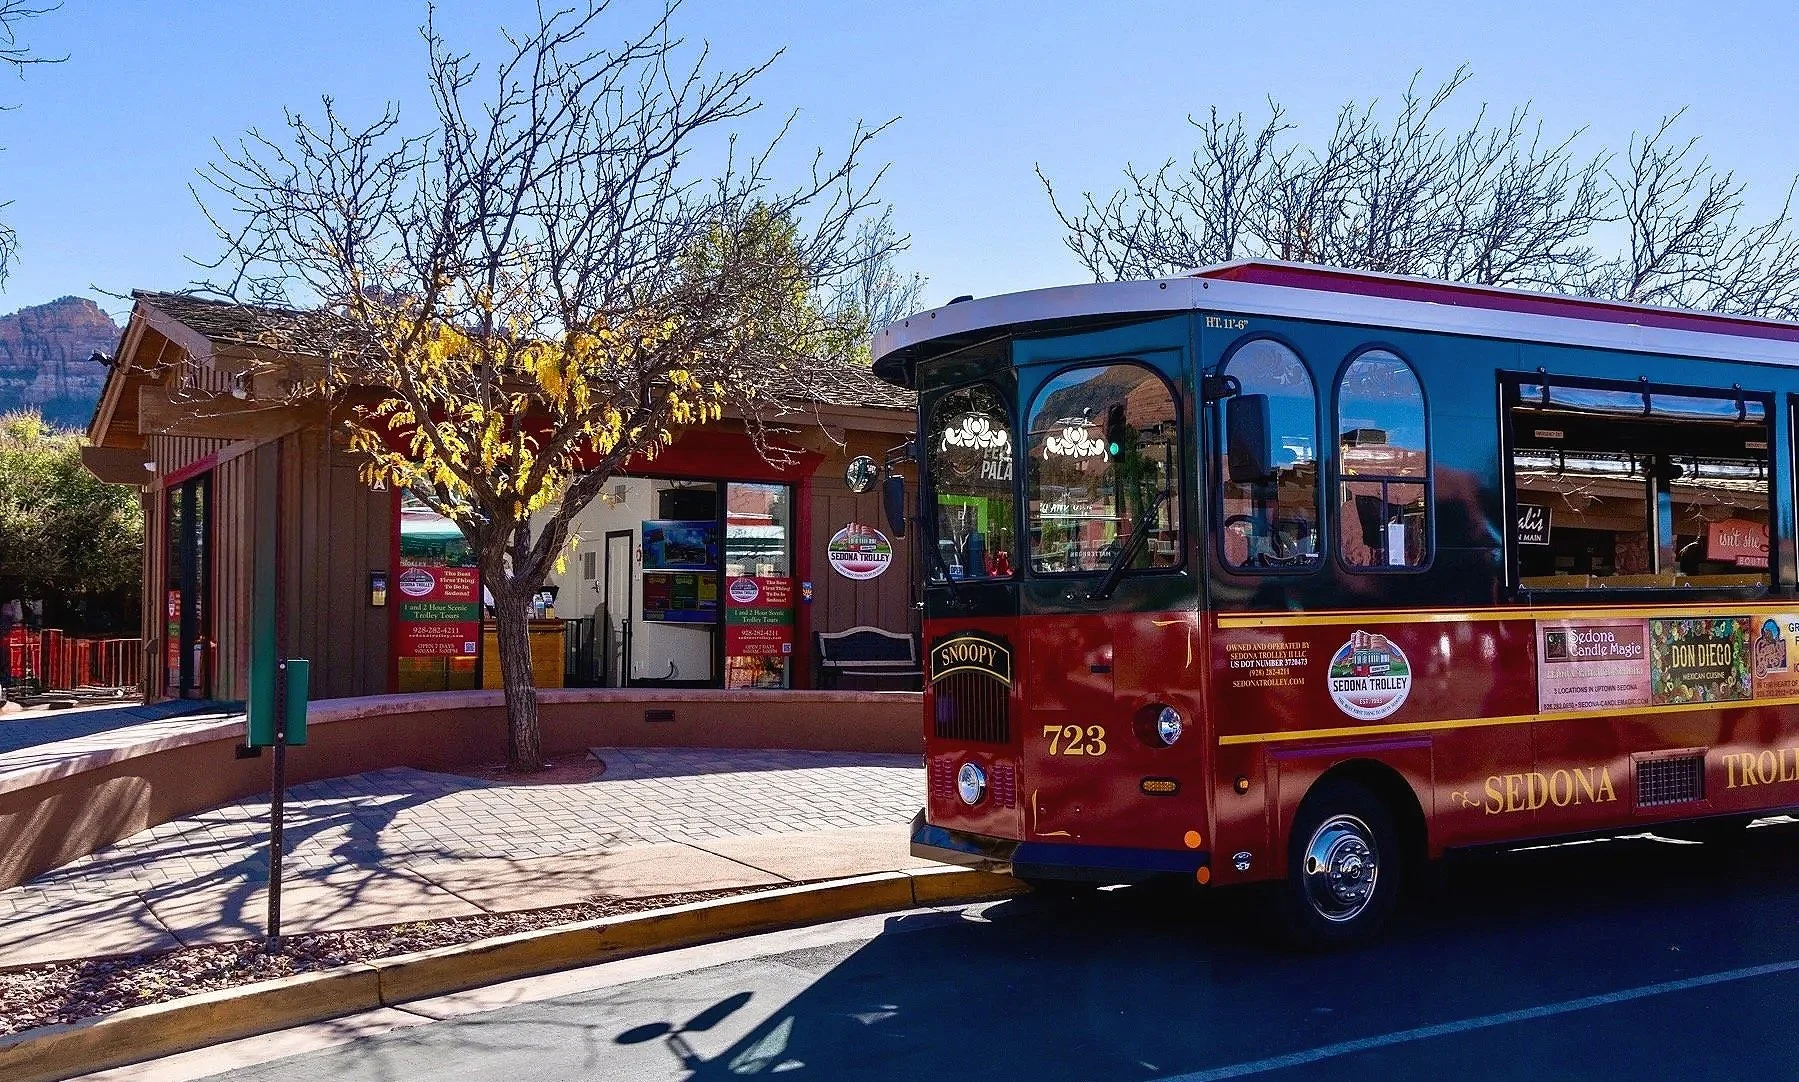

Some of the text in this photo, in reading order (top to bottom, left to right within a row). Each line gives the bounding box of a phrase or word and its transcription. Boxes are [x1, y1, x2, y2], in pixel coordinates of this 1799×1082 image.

[1206, 316, 1222, 328] HT.
[1743, 528, 1760, 549] she
[860, 554, 889, 562] TROLLEY
[1571, 628, 1615, 644] Sedona
[1226, 643, 1251, 652] OWNED
[1268, 642, 1300, 650] OPERATED
[1571, 642, 1641, 657] Candle Magic
[942, 644, 997, 666] SNOOPY
[1672, 645, 1696, 668] DON
[1698, 644, 1731, 666] DIEGO
[1232, 678, 1305, 687] SEDONATROLLEY.COM
[1706, 672, 1725, 680] CUISINE
[1333, 678, 1407, 692] SEDONA TROLLEY
[1043, 724, 1107, 756] 723
[1484, 766, 1618, 815] SEDONA
